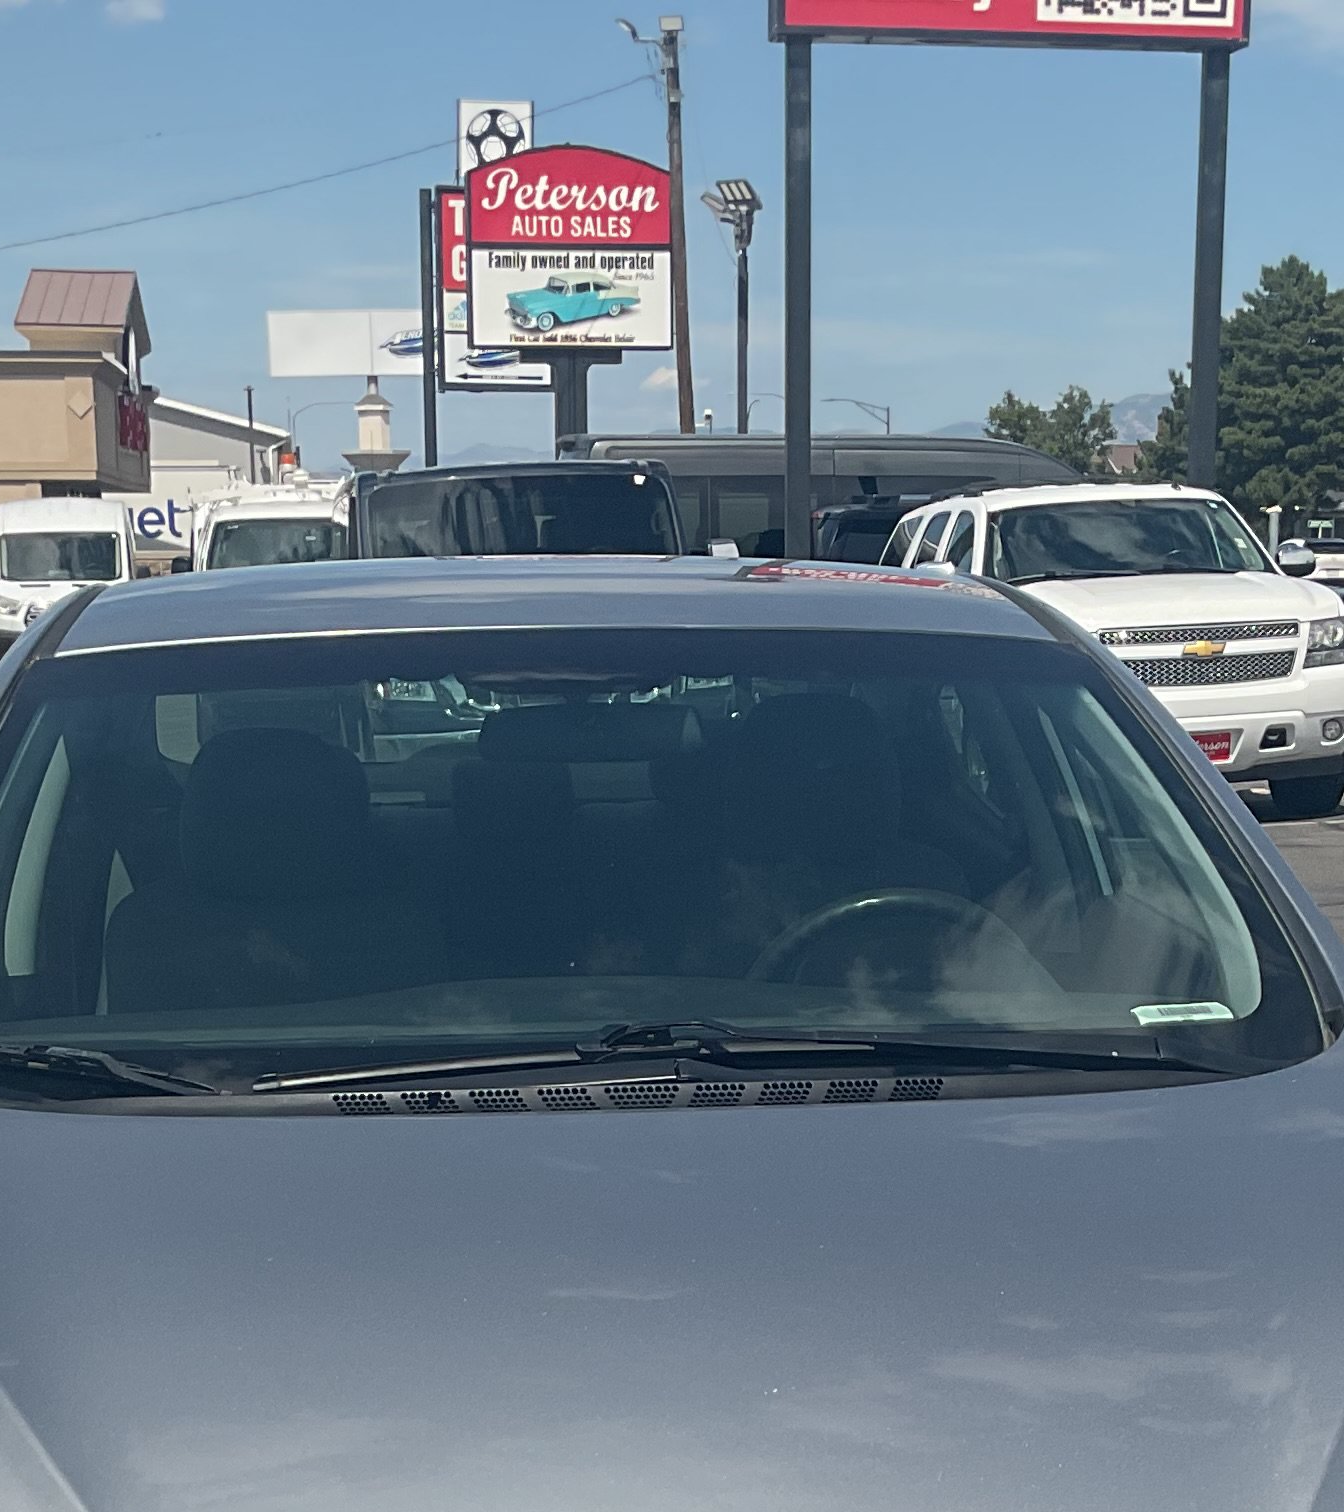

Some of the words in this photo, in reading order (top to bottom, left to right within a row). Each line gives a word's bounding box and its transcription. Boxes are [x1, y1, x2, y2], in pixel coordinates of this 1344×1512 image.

[481, 167, 660, 213] Peterson
[511, 216, 563, 237] AUTO
[570, 216, 632, 238] SALES
[488, 251, 526, 272] Family
[531, 252, 570, 269] owned
[574, 252, 596, 269] and
[600, 252, 654, 273] operated
